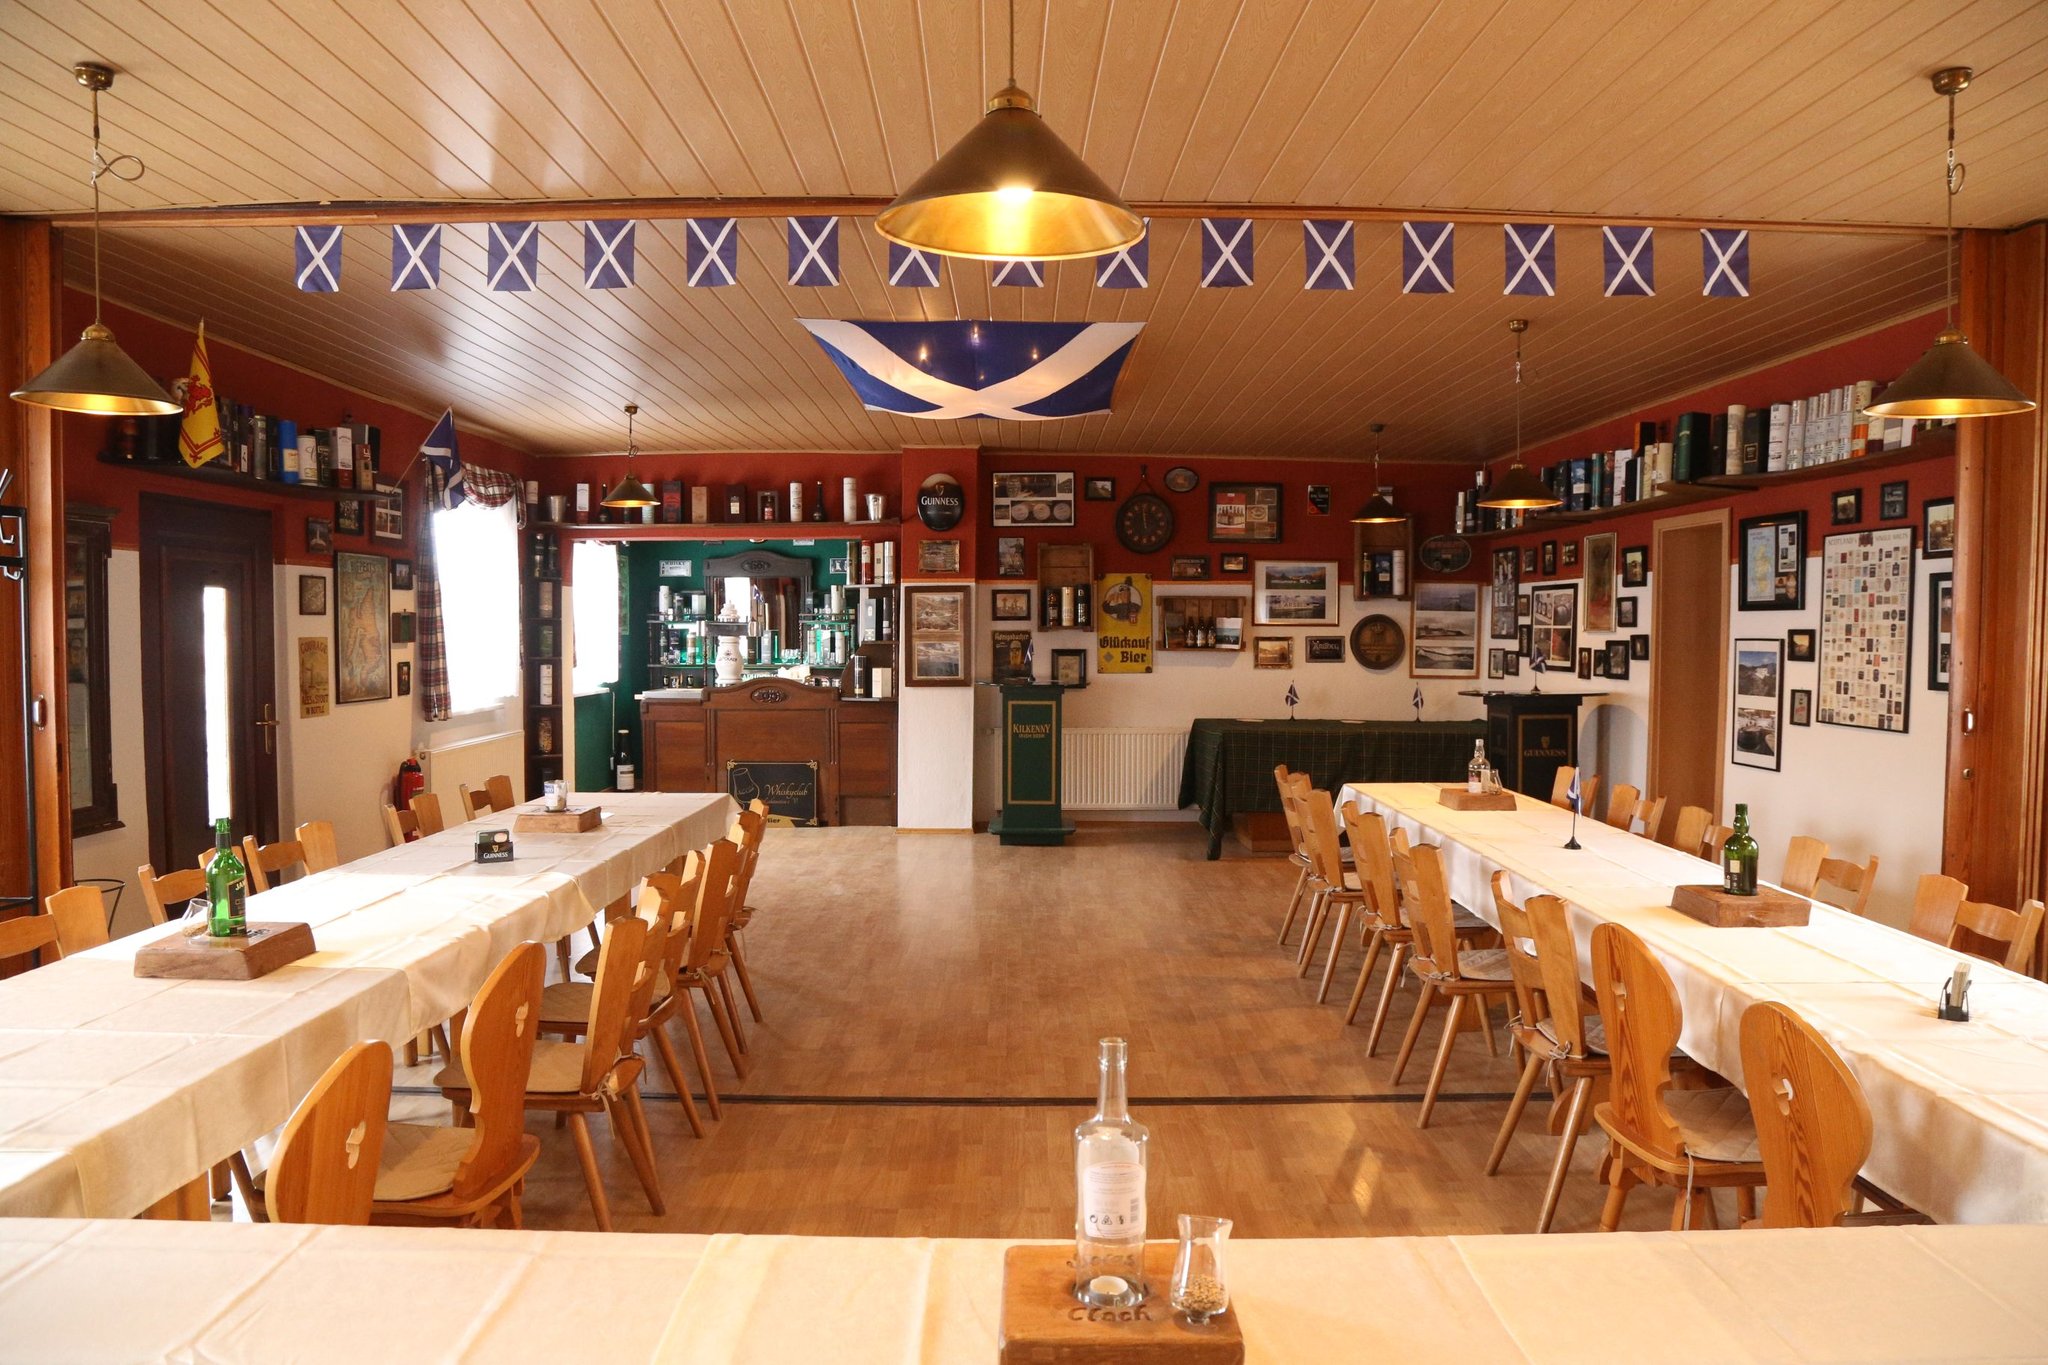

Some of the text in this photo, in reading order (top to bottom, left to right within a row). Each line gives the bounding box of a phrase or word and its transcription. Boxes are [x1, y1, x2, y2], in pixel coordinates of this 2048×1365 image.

[921, 496, 959, 506] GUINNESS
[1100, 636, 1150, 650] Glückauf
[1120, 651, 1147, 664] Bier
[1013, 723, 1051, 733] KILKENNY
[1524, 749, 1567, 757] GUINNESS
